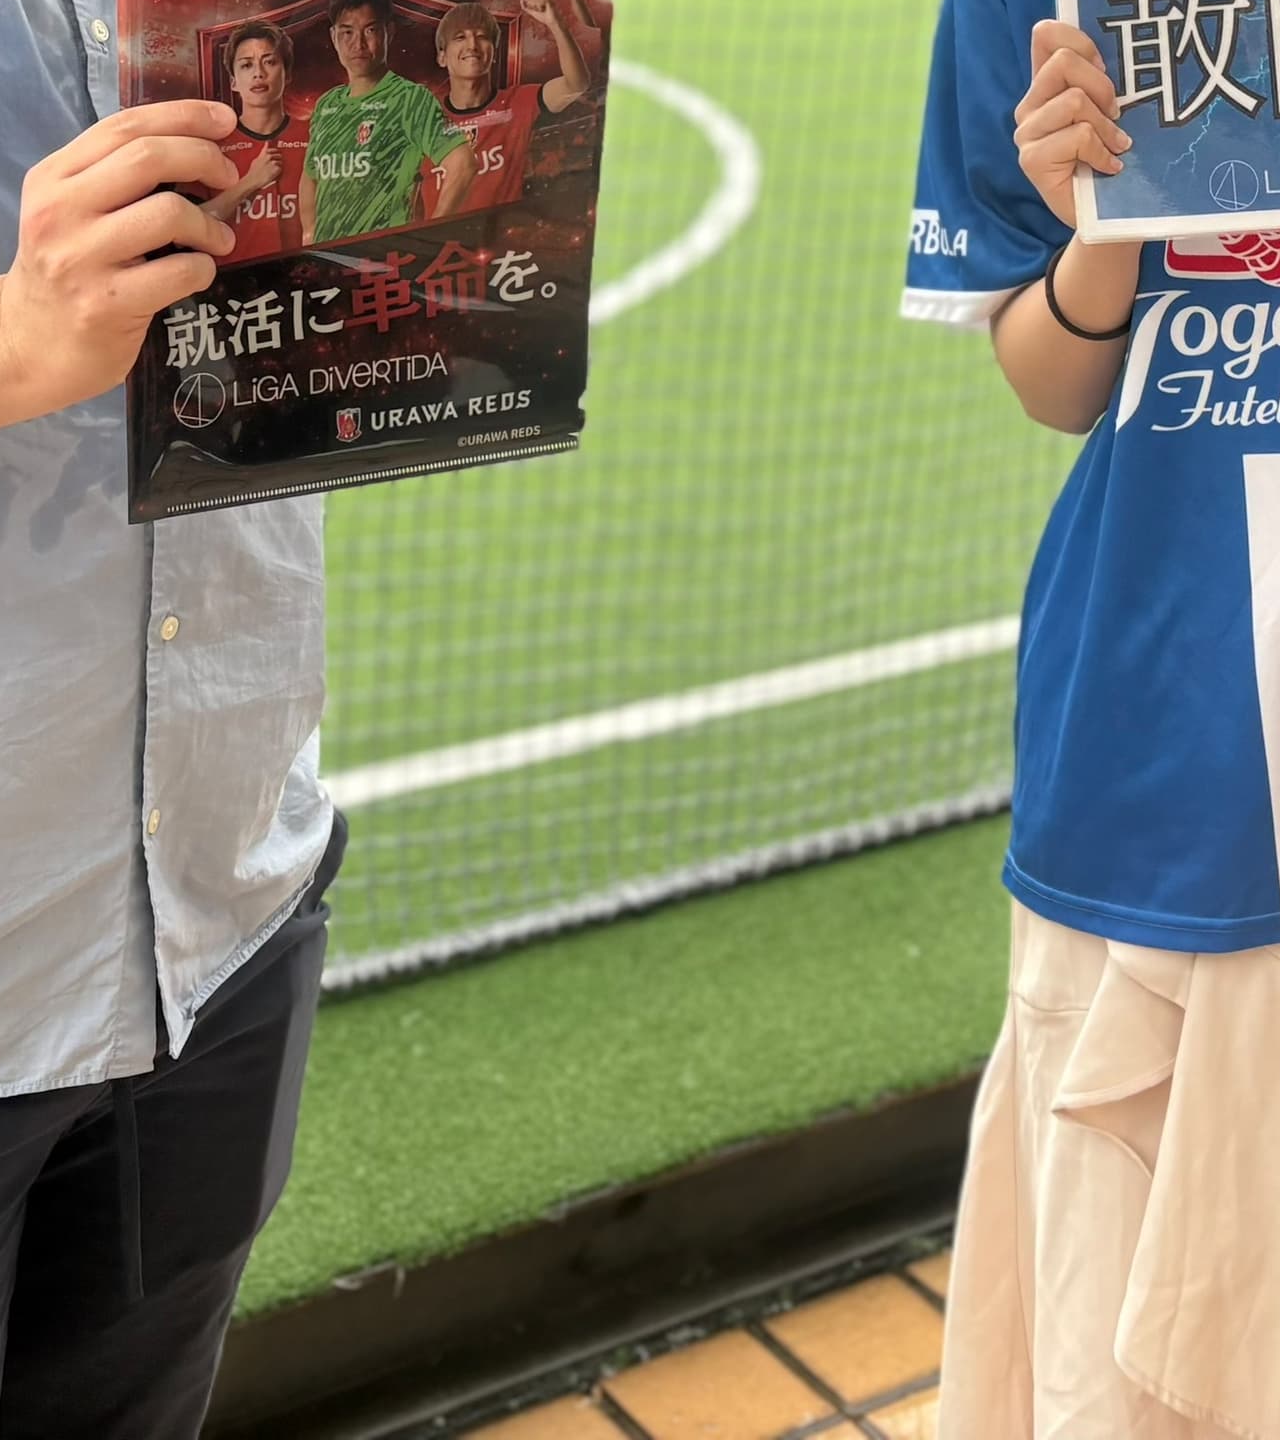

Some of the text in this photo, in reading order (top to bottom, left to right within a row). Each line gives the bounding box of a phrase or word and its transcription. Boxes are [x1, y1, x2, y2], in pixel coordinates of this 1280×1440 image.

[164, 240, 557, 368] 就活に革命を。
[371, 389, 532, 431] URAWA REDS
[511, 425, 541, 440] REDS
